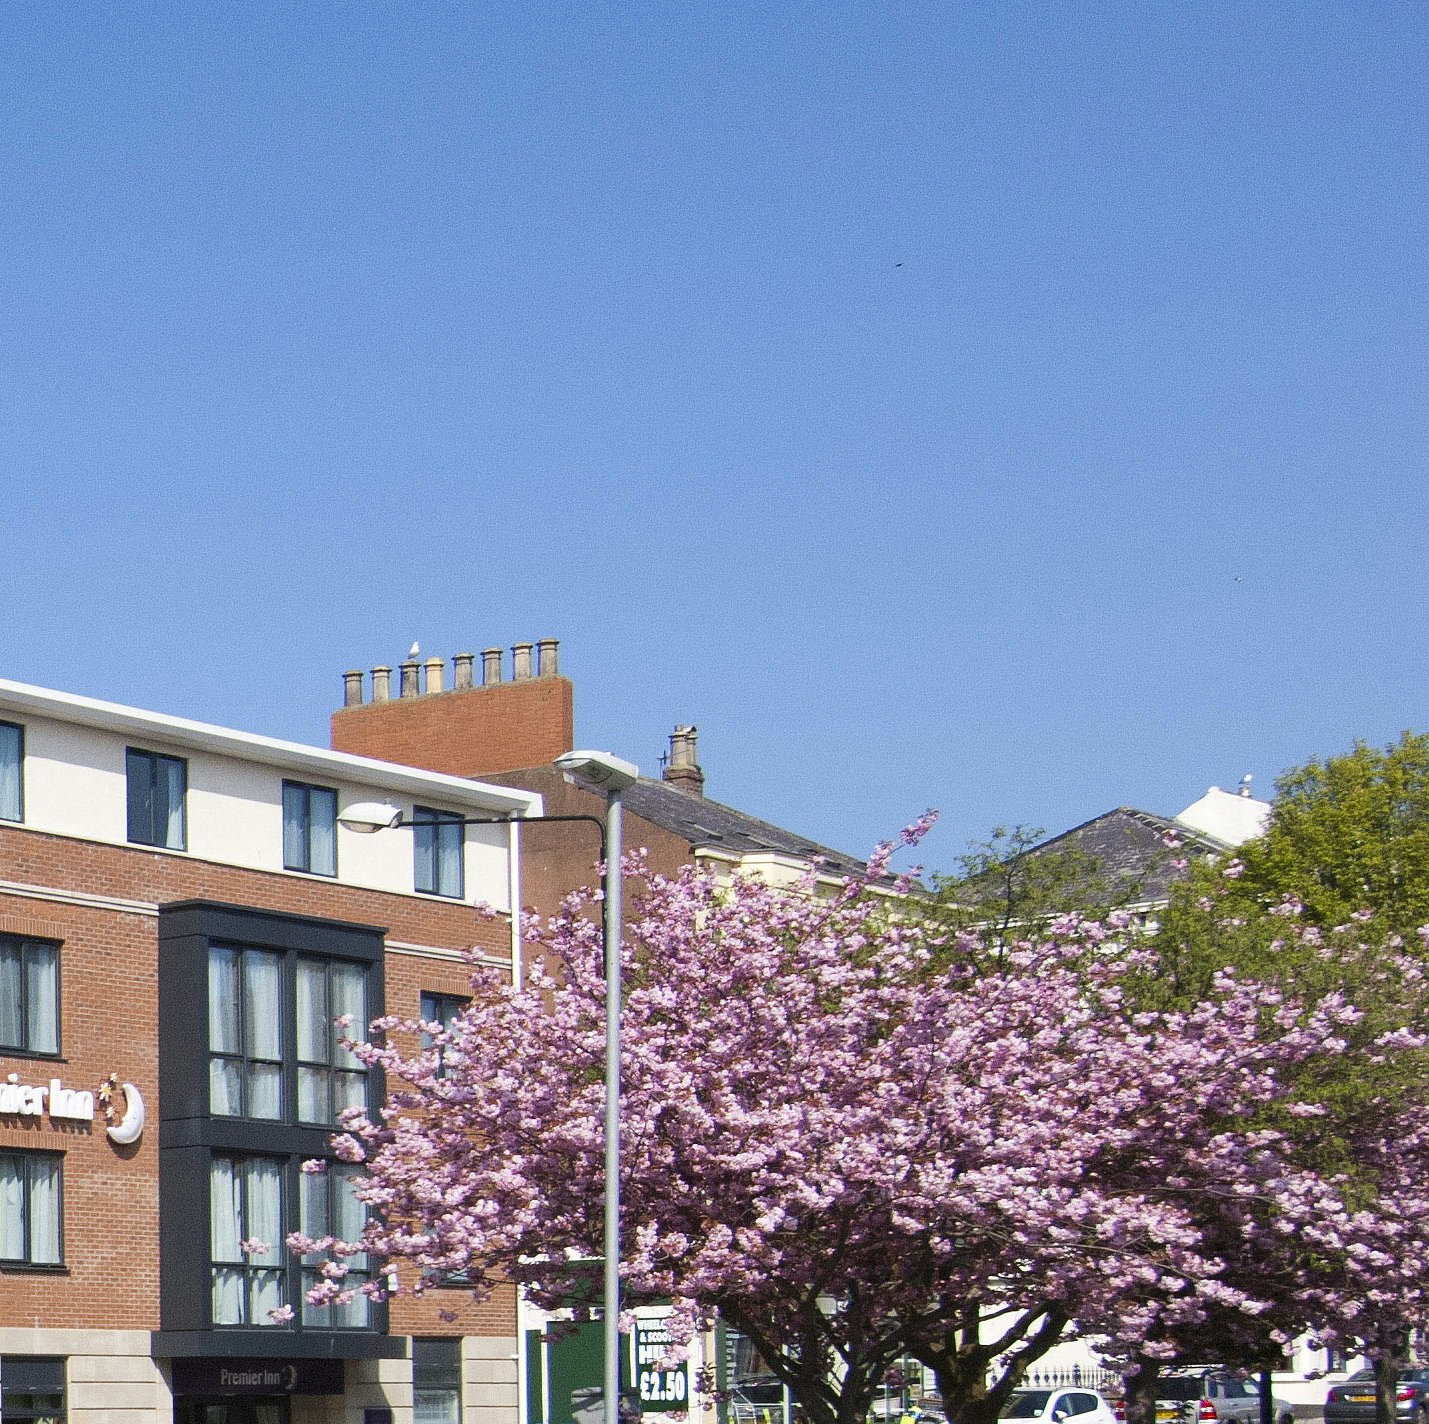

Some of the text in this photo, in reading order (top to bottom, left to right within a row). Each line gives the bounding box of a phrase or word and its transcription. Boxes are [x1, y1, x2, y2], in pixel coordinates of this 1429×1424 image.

[49, 1078, 94, 1120] Inn
[220, 1368, 280, 1386] Premier Inn
[640, 1371, 685, 1401] £2.50
